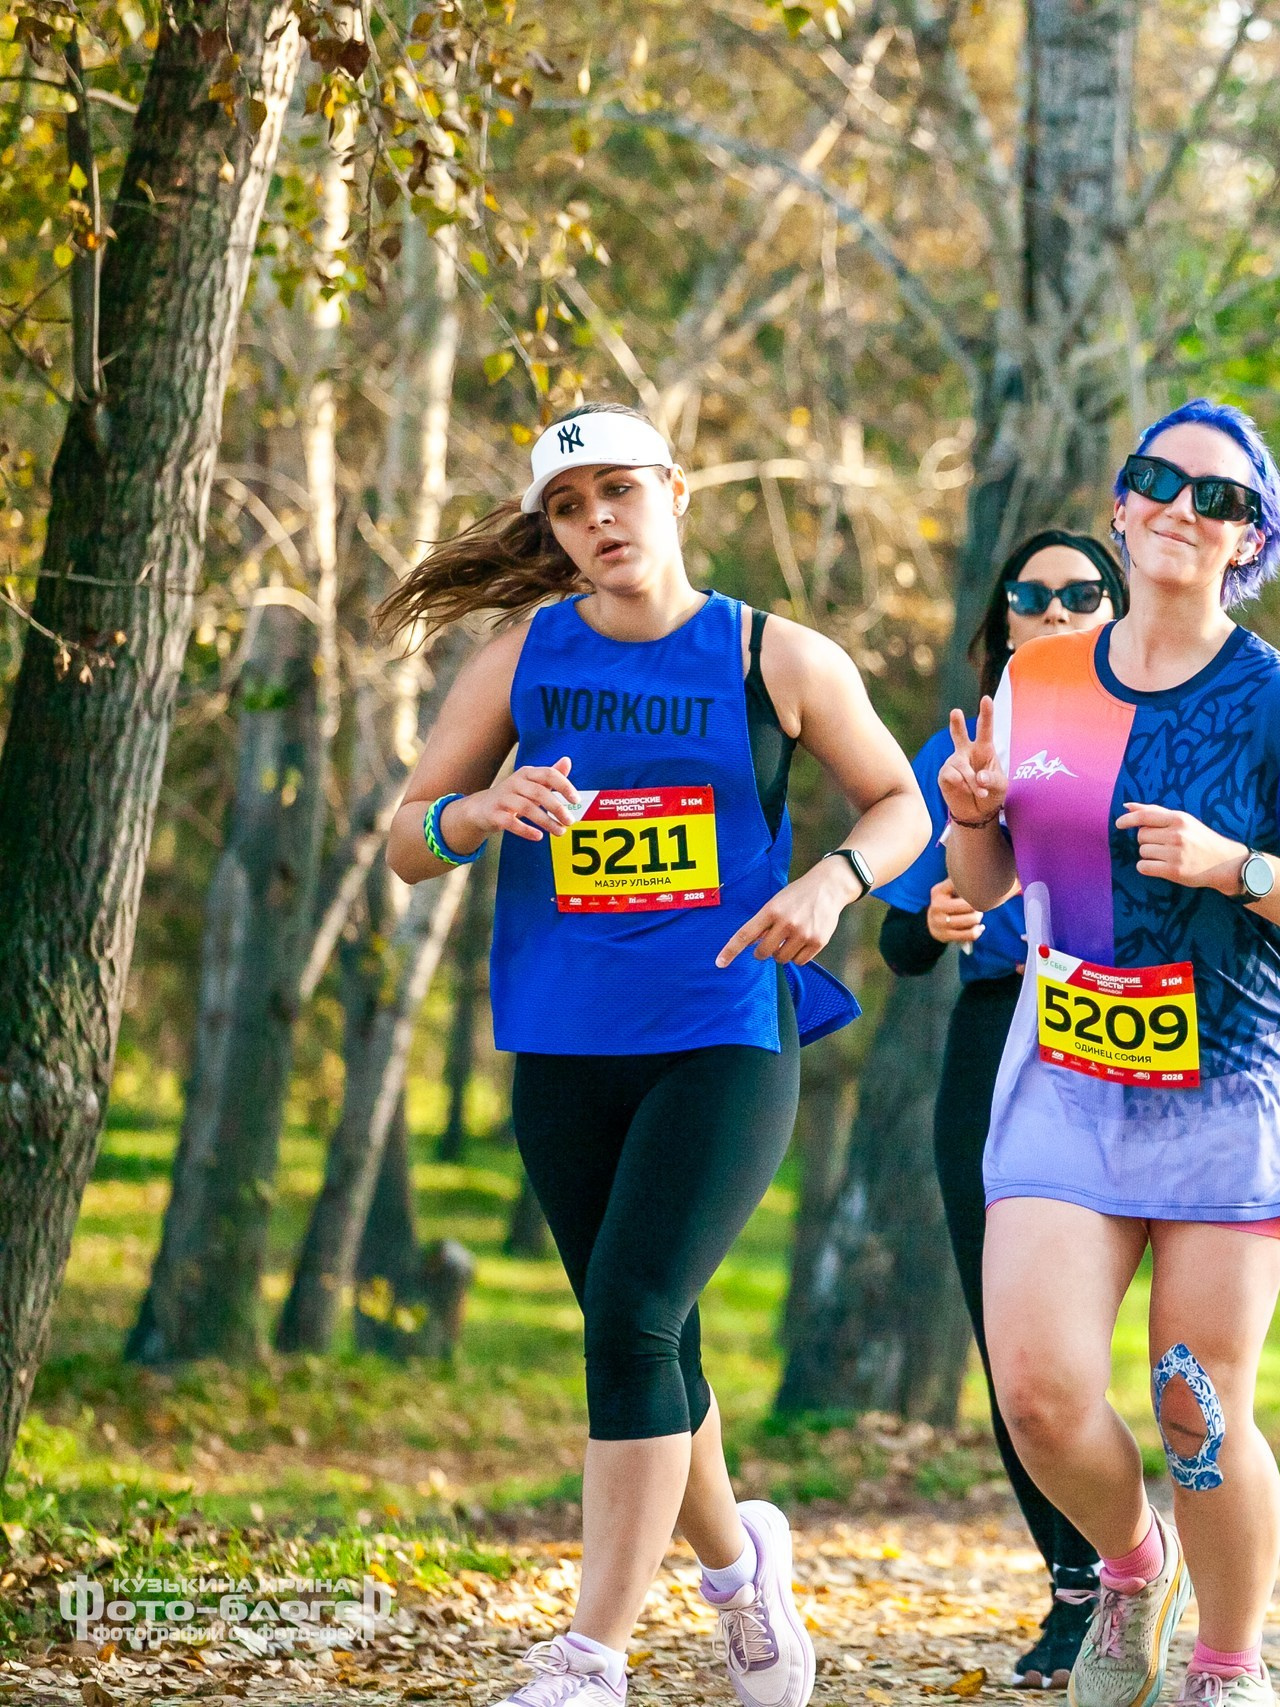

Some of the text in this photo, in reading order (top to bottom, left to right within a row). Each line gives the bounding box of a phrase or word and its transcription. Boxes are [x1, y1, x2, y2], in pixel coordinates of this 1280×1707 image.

[557, 423, 585, 454] NY
[541, 686, 715, 737] WORKOUT
[1013, 766, 1038, 779] SRF
[600, 796, 661, 806] КРАСНОЯРСКИЕ
[688, 798, 703, 806] КМ
[616, 804, 645, 812] МОСТЫ
[571, 824, 697, 876] 5211
[594, 876, 672, 888] МАЗУР УЛЬЯНА
[684, 892, 705, 901] 2026
[1050, 960, 1068, 972] СБЕР
[1082, 969, 1141, 984] КРАСНОЯРСКИЕ
[1161, 977, 1182, 987] 5 КМ
[1097, 979, 1124, 990] МОСТЫ
[1044, 984, 1189, 1052] 5209
[1074, 1041, 1152, 1063] ОДИНЕЦ СОФИЯ
[1161, 1073, 1183, 1081] 2026
